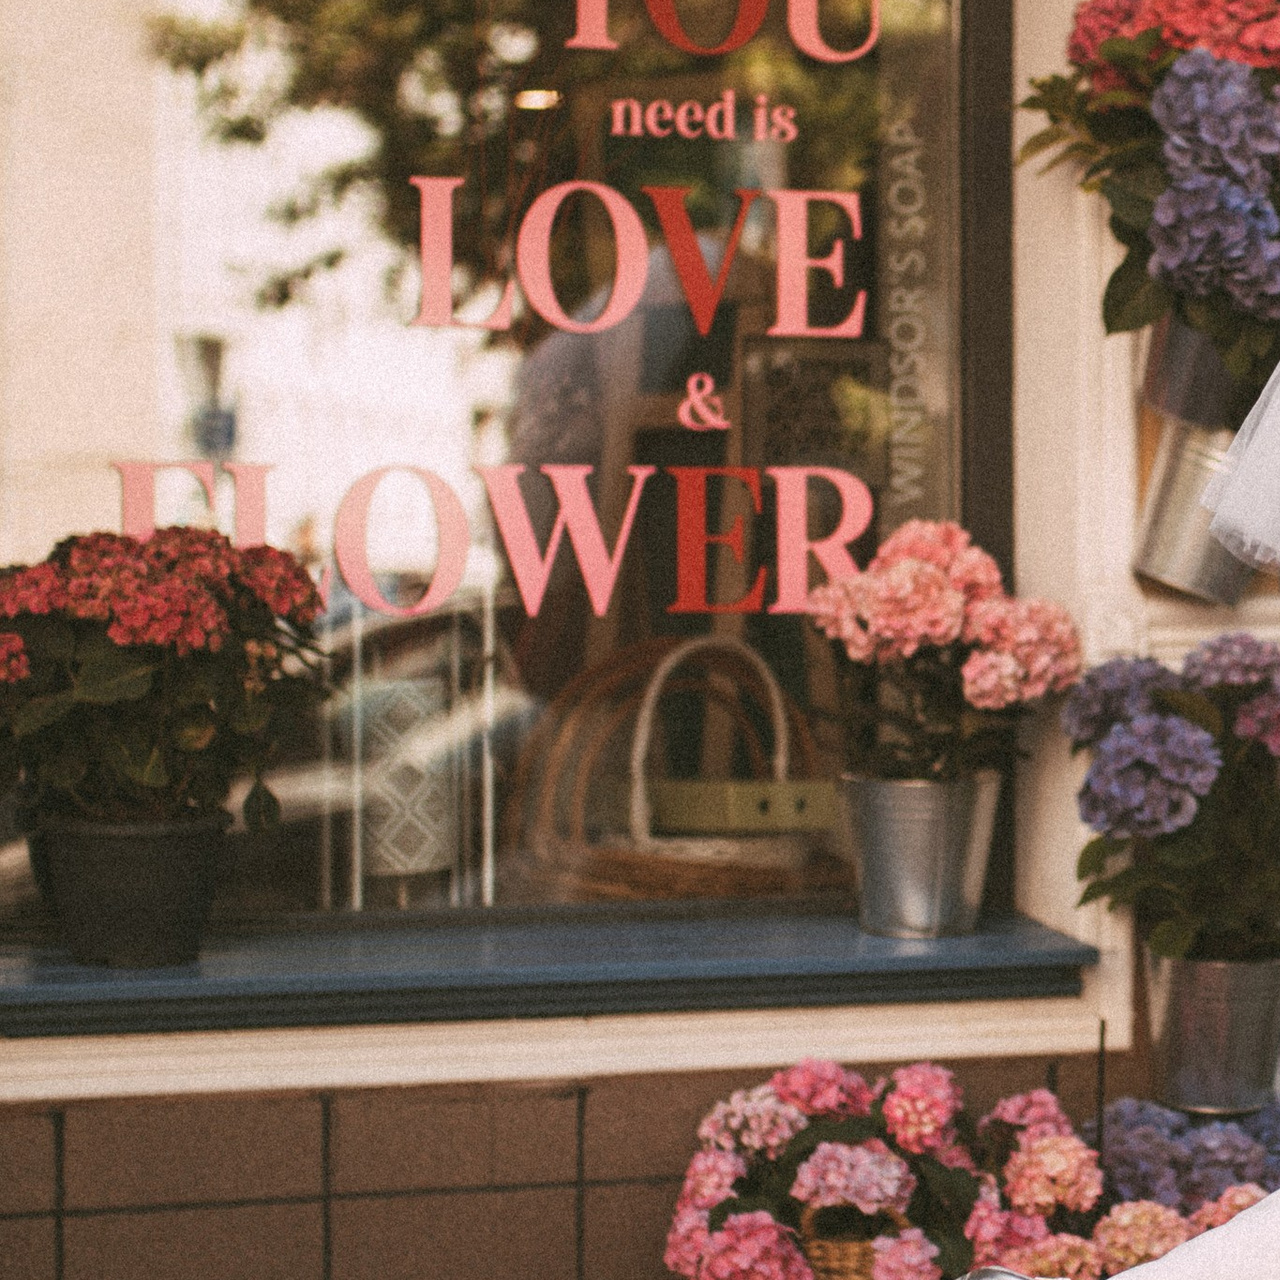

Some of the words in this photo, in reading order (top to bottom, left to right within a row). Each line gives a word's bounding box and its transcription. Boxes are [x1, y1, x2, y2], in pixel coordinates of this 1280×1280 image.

[610, 89, 736, 141] need
[754, 92, 799, 143] is
[887, 117, 925, 239] SOAP
[405, 175, 869, 338] LOVE
[677, 371, 732, 433] &
[887, 252, 924, 504] WINDSOR'S
